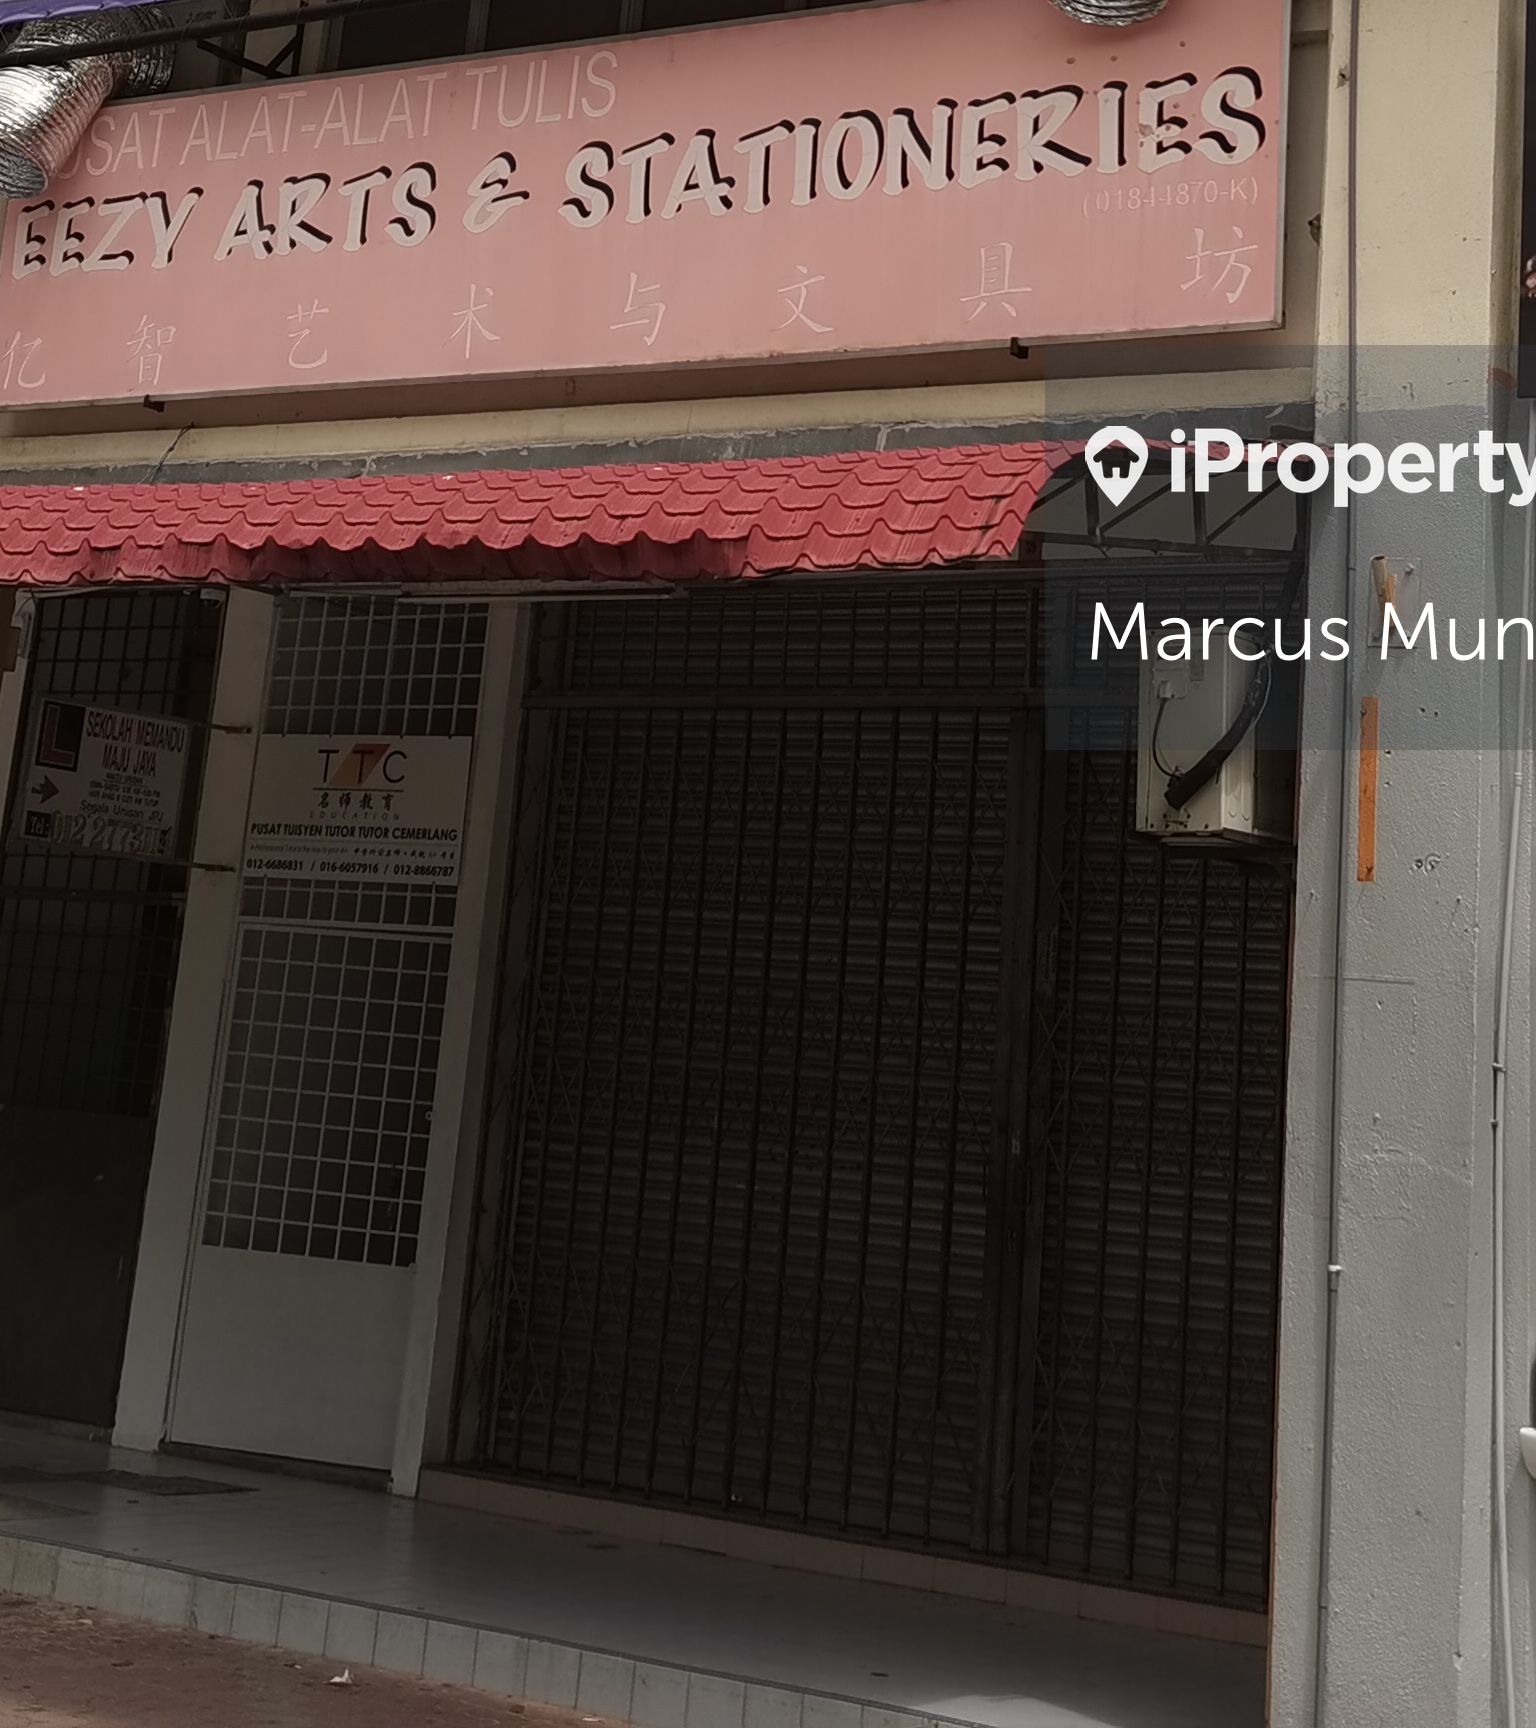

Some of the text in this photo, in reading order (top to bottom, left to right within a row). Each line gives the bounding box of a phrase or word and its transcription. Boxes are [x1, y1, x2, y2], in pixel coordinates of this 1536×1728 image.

[178, 70, 448, 168] ALAT-ALAT
[465, 49, 619, 132] TULIS
[11, 186, 204, 282] EEZY
[214, 160, 438, 263] ARTS
[558, 66, 1266, 229] STATIONERIES
[85, 710, 186, 754] SEKOLAH MEMANDU
[101, 744, 158, 777] MAJU JAYA
[317, 748, 409, 784] TTC
[251, 823, 458, 841] PUSAT TUISYEN TUTOR TUTOR CEMERLANG
